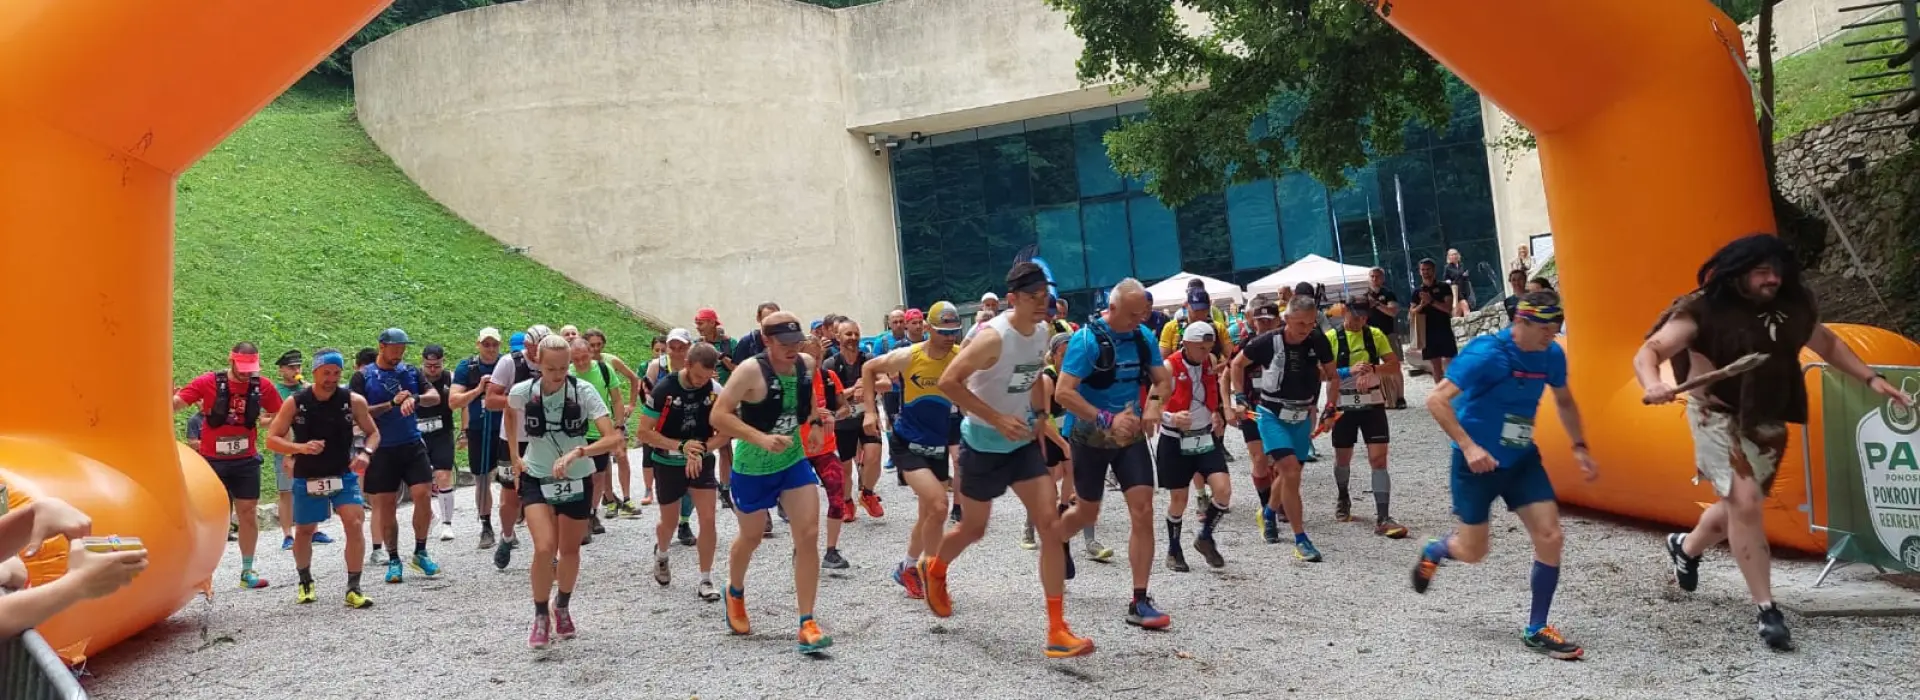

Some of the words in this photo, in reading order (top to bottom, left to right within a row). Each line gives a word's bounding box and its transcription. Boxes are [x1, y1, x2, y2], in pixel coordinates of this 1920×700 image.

[1354, 395, 1360, 404] 8
[775, 415, 792, 429] 21
[227, 441, 240, 450] 18
[1194, 436, 1201, 448] 7
[1864, 441, 1919, 470] PA
[1885, 473, 1920, 481] PONOS
[317, 480, 331, 491] 31
[554, 481, 572, 495] 34
[1879, 512, 1920, 529] REKREAT
